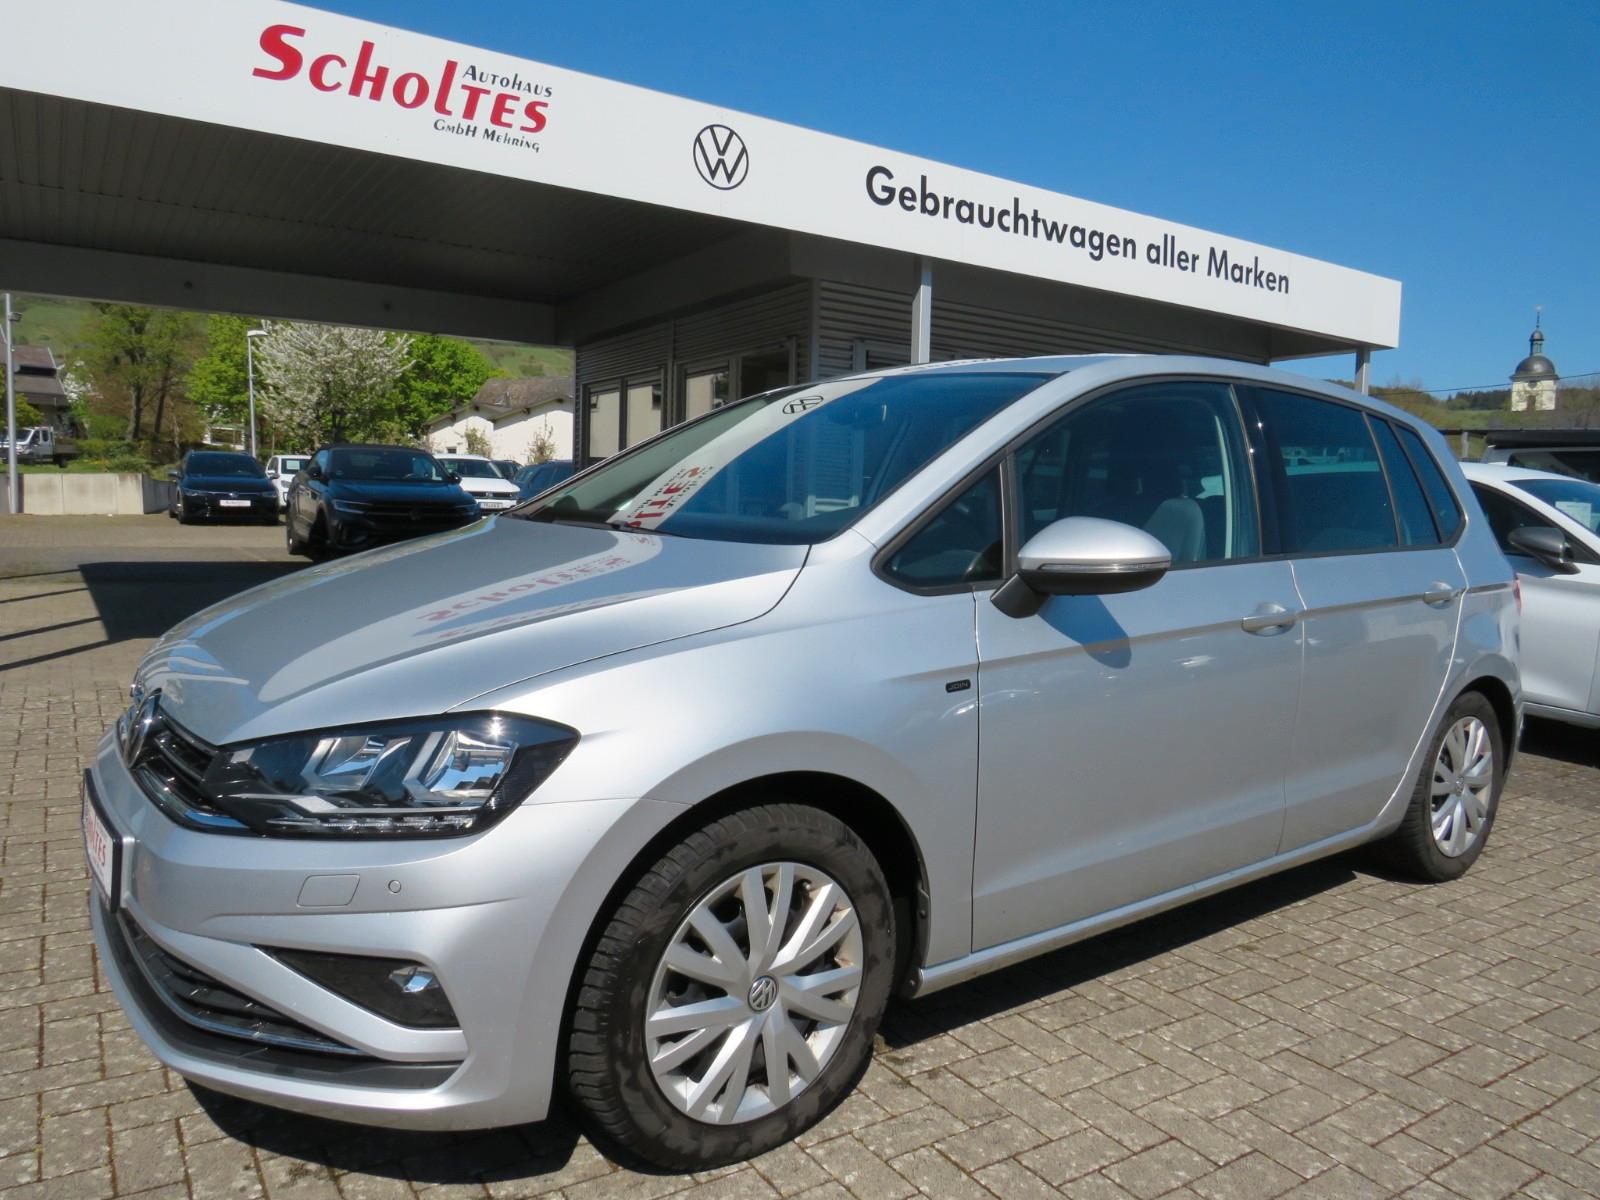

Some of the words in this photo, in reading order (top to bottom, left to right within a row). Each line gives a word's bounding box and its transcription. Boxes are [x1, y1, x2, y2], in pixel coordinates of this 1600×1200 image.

[865, 165, 1137, 261] Gebrauchtwagen
[1146, 233, 1200, 273] aller
[1207, 246, 1289, 294] Marken
